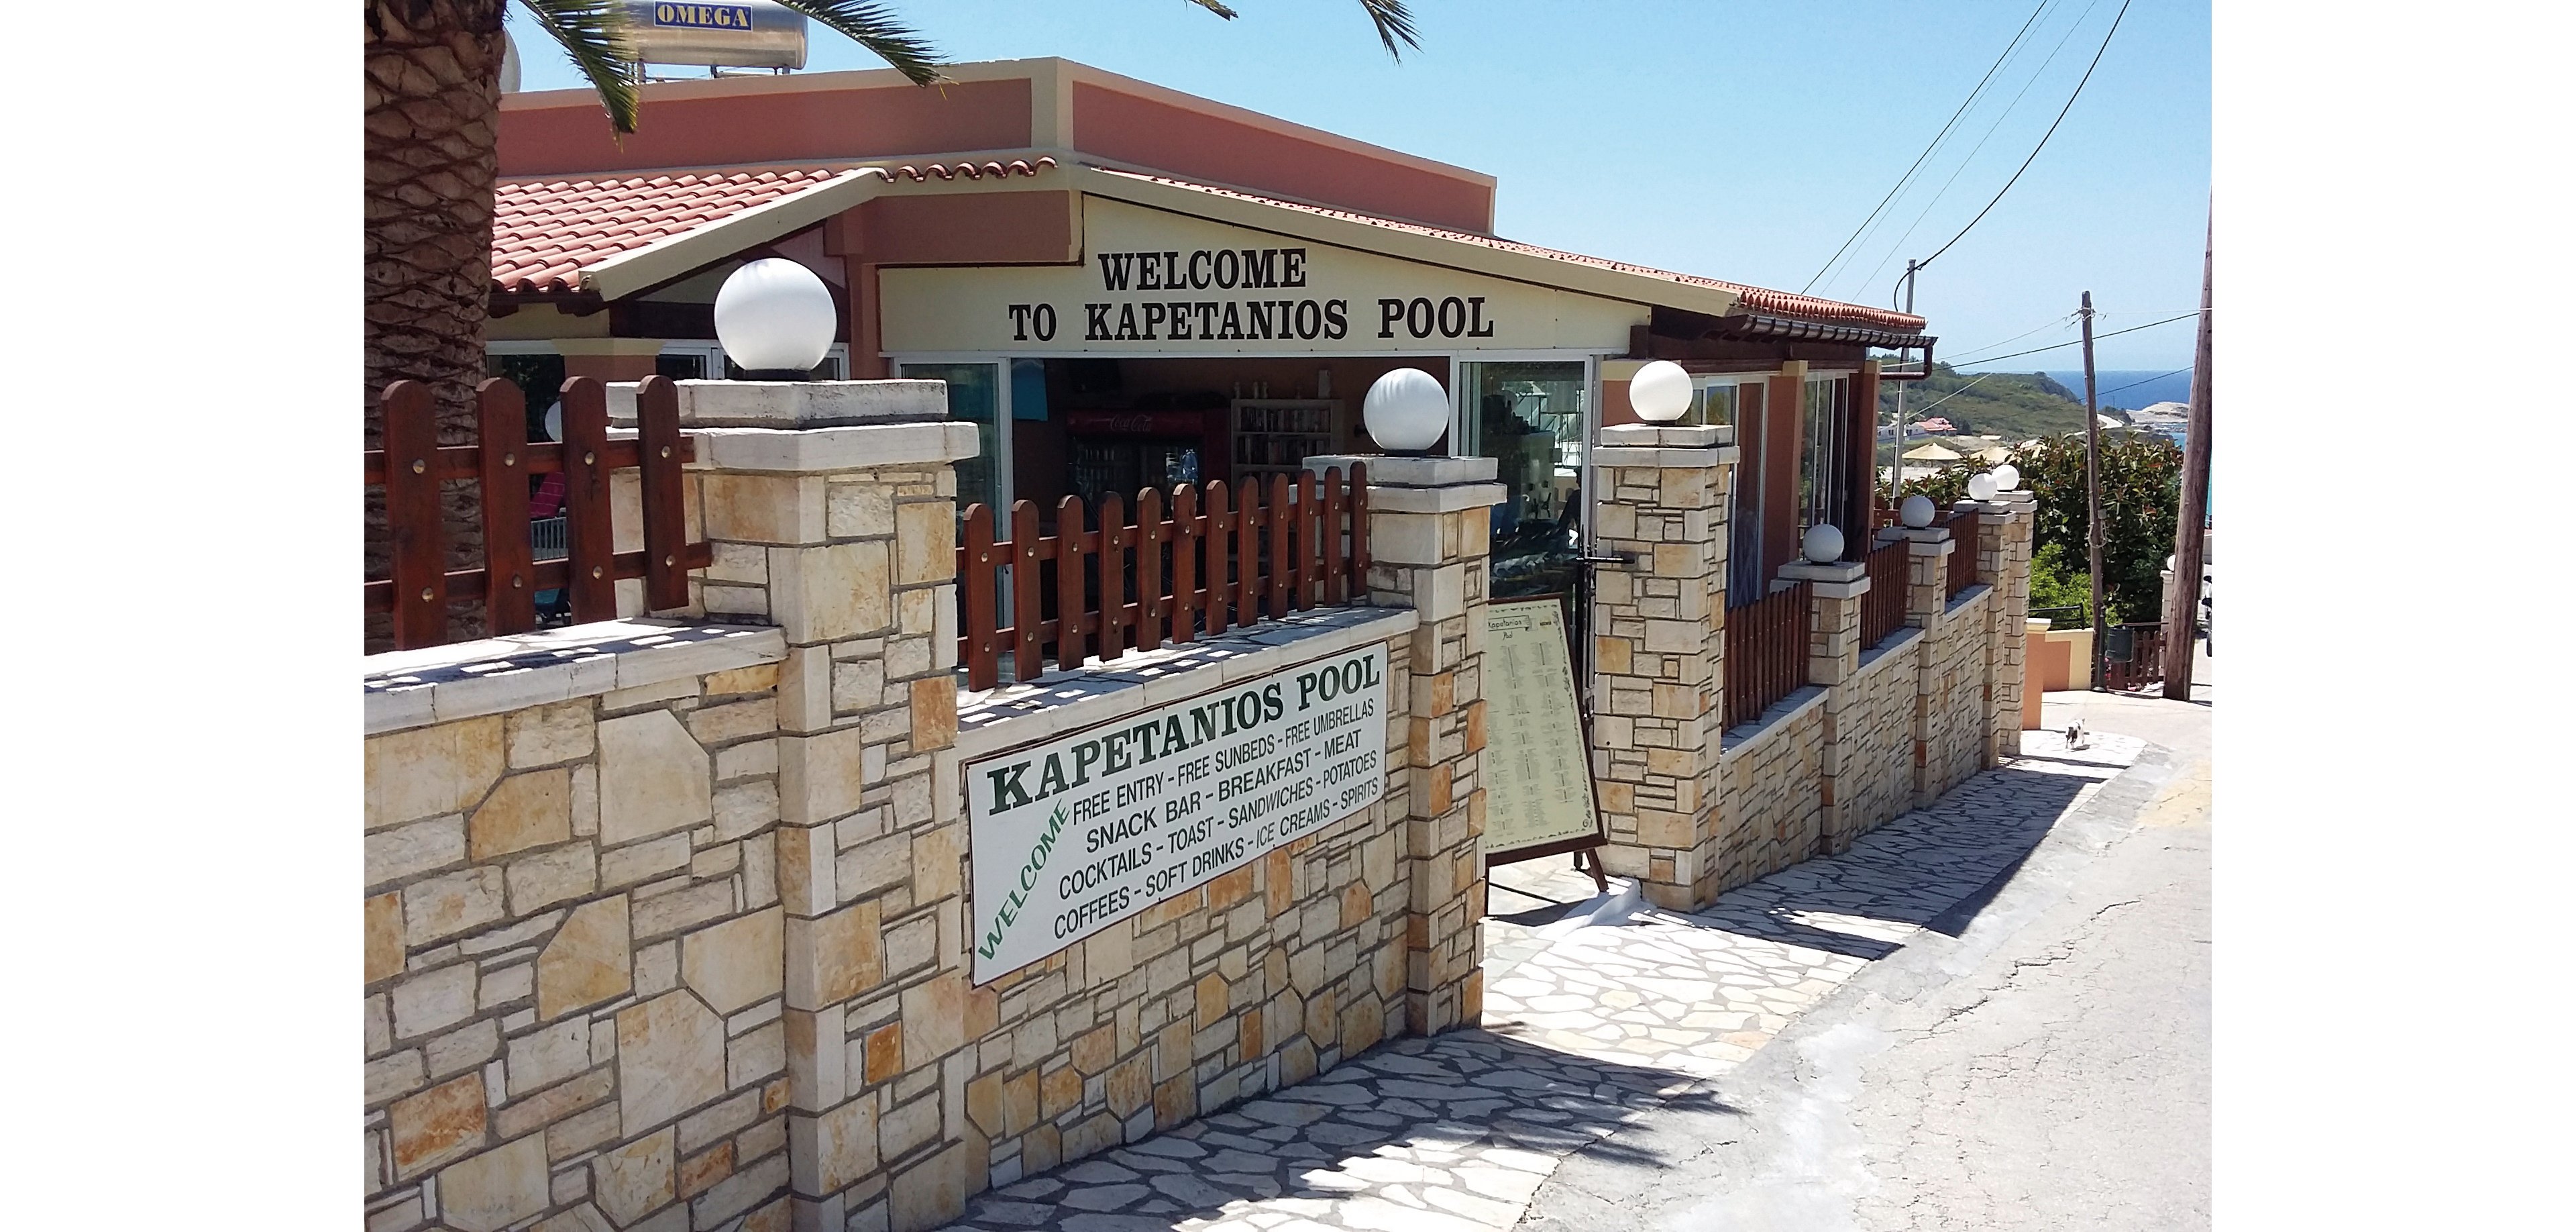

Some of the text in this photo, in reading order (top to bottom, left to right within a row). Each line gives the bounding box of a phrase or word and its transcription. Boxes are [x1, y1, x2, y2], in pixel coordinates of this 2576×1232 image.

[657, 4, 749, 27] OMEGA
[1009, 297, 1494, 341] TO KAPETANIOS POOL
[1098, 248, 1306, 291] WELCOME
[987, 654, 1380, 816] KAPETANIOS POOL
[1073, 790, 1110, 825] FREE
[1117, 772, 1164, 808] ENTRY
[1178, 756, 1210, 786] FREE
[1216, 734, 1275, 772] SUNBEDS
[1285, 720, 1309, 748] FREE
[1313, 698, 1374, 735] UMBRELLAS
[1087, 807, 1157, 853] SNACK
[1166, 790, 1201, 823] BAR
[1219, 748, 1311, 801] BREAKFAST
[1324, 729, 1361, 759] MEAT
[978, 798, 1071, 960] WELCOME
[1054, 886, 1130, 939] COFFEES
[1145, 861, 1187, 897] SOFT
[1193, 837, 1244, 877] DRINKS
[1256, 821, 1275, 848] ICE
[1280, 799, 1330, 836] CREAMS
[1341, 776, 1378, 810] SPIRITS
[1059, 842, 1152, 900] COCKTAILS
[1168, 816, 1214, 854] TOAST
[1228, 776, 1313, 829] SANDWICHES
[1324, 750, 1377, 788] POTATOES
